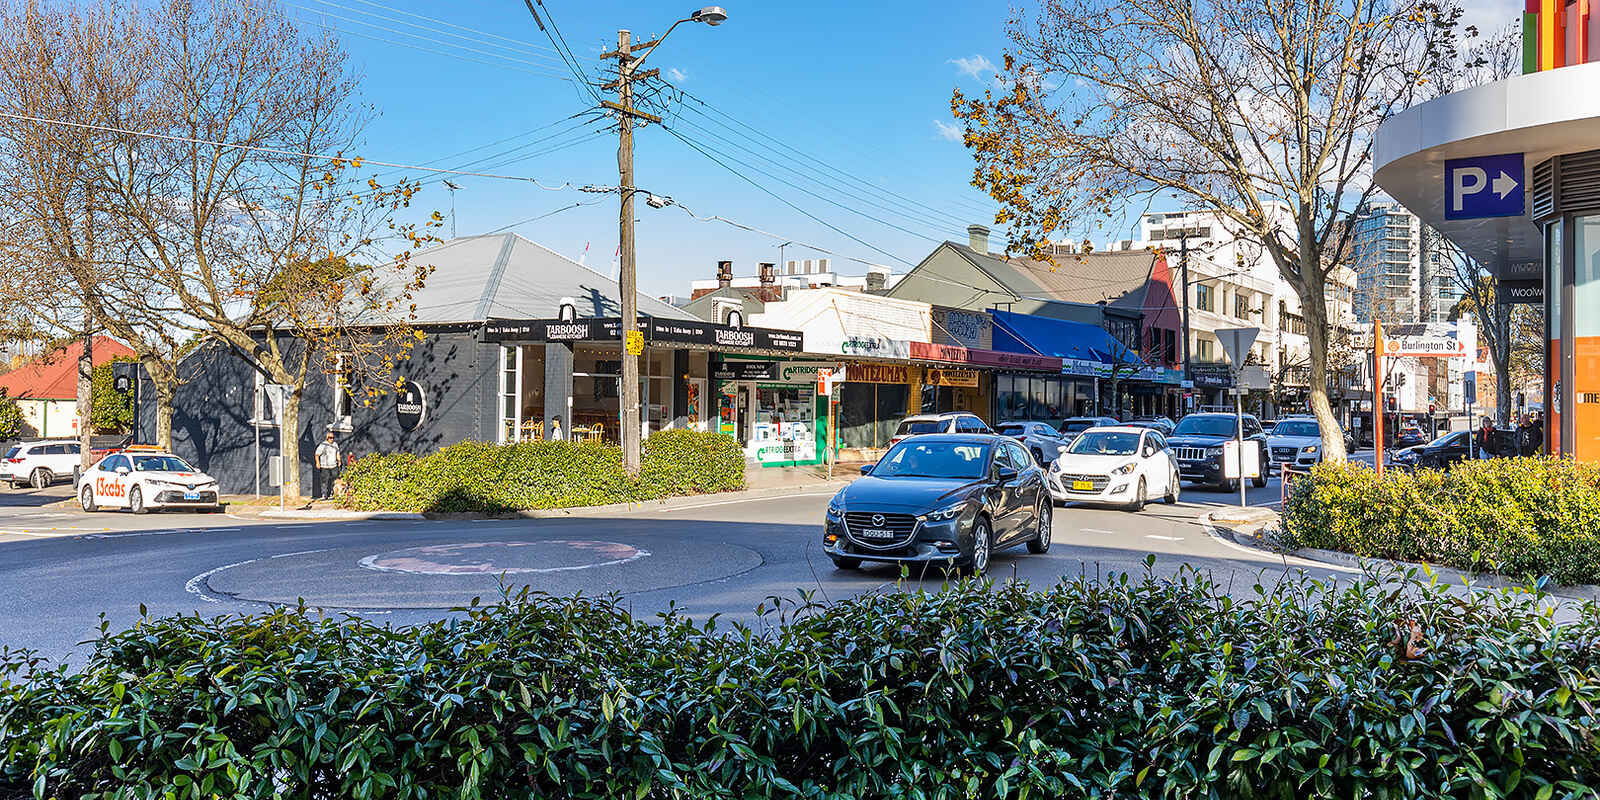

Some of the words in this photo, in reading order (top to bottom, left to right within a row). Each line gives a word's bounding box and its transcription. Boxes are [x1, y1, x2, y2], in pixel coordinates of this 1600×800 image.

[1453, 167, 1487, 211] P
[546, 325, 588, 338] TARBOOSH
[715, 329, 754, 345] TARBOOSH
[1402, 341, 1444, 352] Burlington
[1446, 341, 1456, 350] St
[845, 365, 908, 382] MONTEZUMA'S
[96, 477, 126, 497] 13cabs
